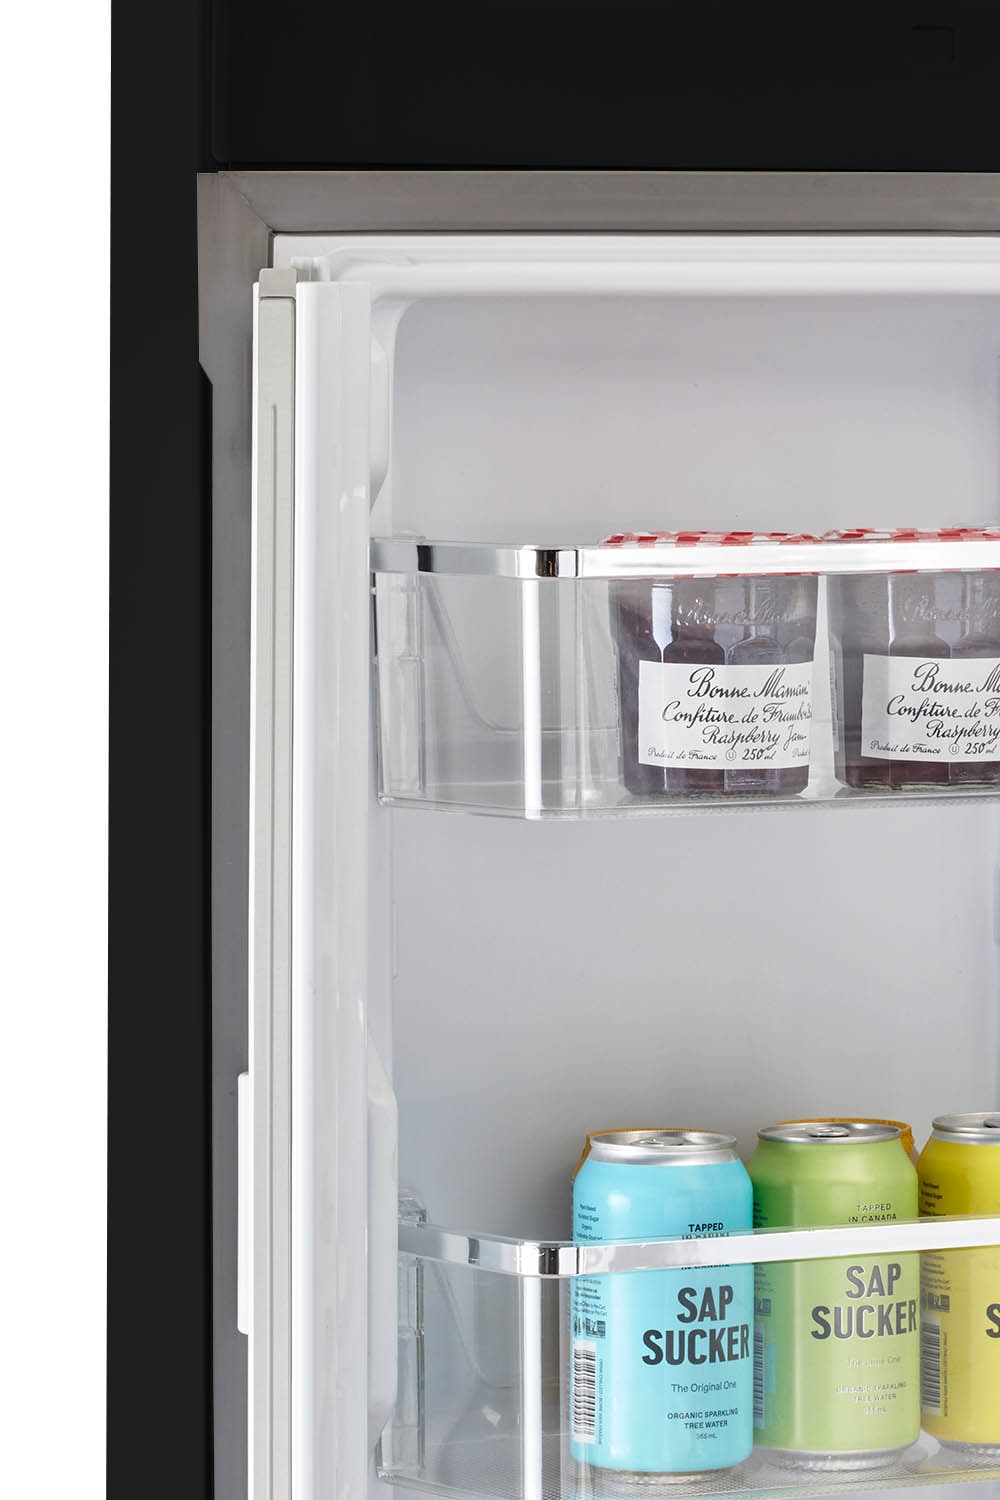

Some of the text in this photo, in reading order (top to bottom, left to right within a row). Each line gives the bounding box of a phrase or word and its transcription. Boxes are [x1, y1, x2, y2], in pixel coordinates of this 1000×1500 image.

[686, 666, 751, 698] Bonne
[911, 661, 974, 693] Bonne
[662, 700, 759, 728] Confiture de
[886, 694, 980, 722] Confiture de
[702, 724, 780, 750] Raspberry
[926, 718, 1000, 744] Raspberry
[688, 749, 717, 761] France
[741, 748, 765, 760] 250
[912, 743, 941, 754] France
[964, 742, 985, 754] 250
[856, 1202, 892, 1212] TAPPED
[687, 1222, 724, 1233] TAPPED
[845, 1263, 902, 1299] SAP
[676, 1284, 734, 1324] SAP
[810, 1299, 918, 1341] SUCKER
[641, 1323, 750, 1366] SUCKER
[671, 1383, 689, 1393] The
[690, 1380, 723, 1394] Original
[667, 1407, 739, 1420] ORGANIC SPARKLING
[684, 1419, 728, 1430] TREE WATER
